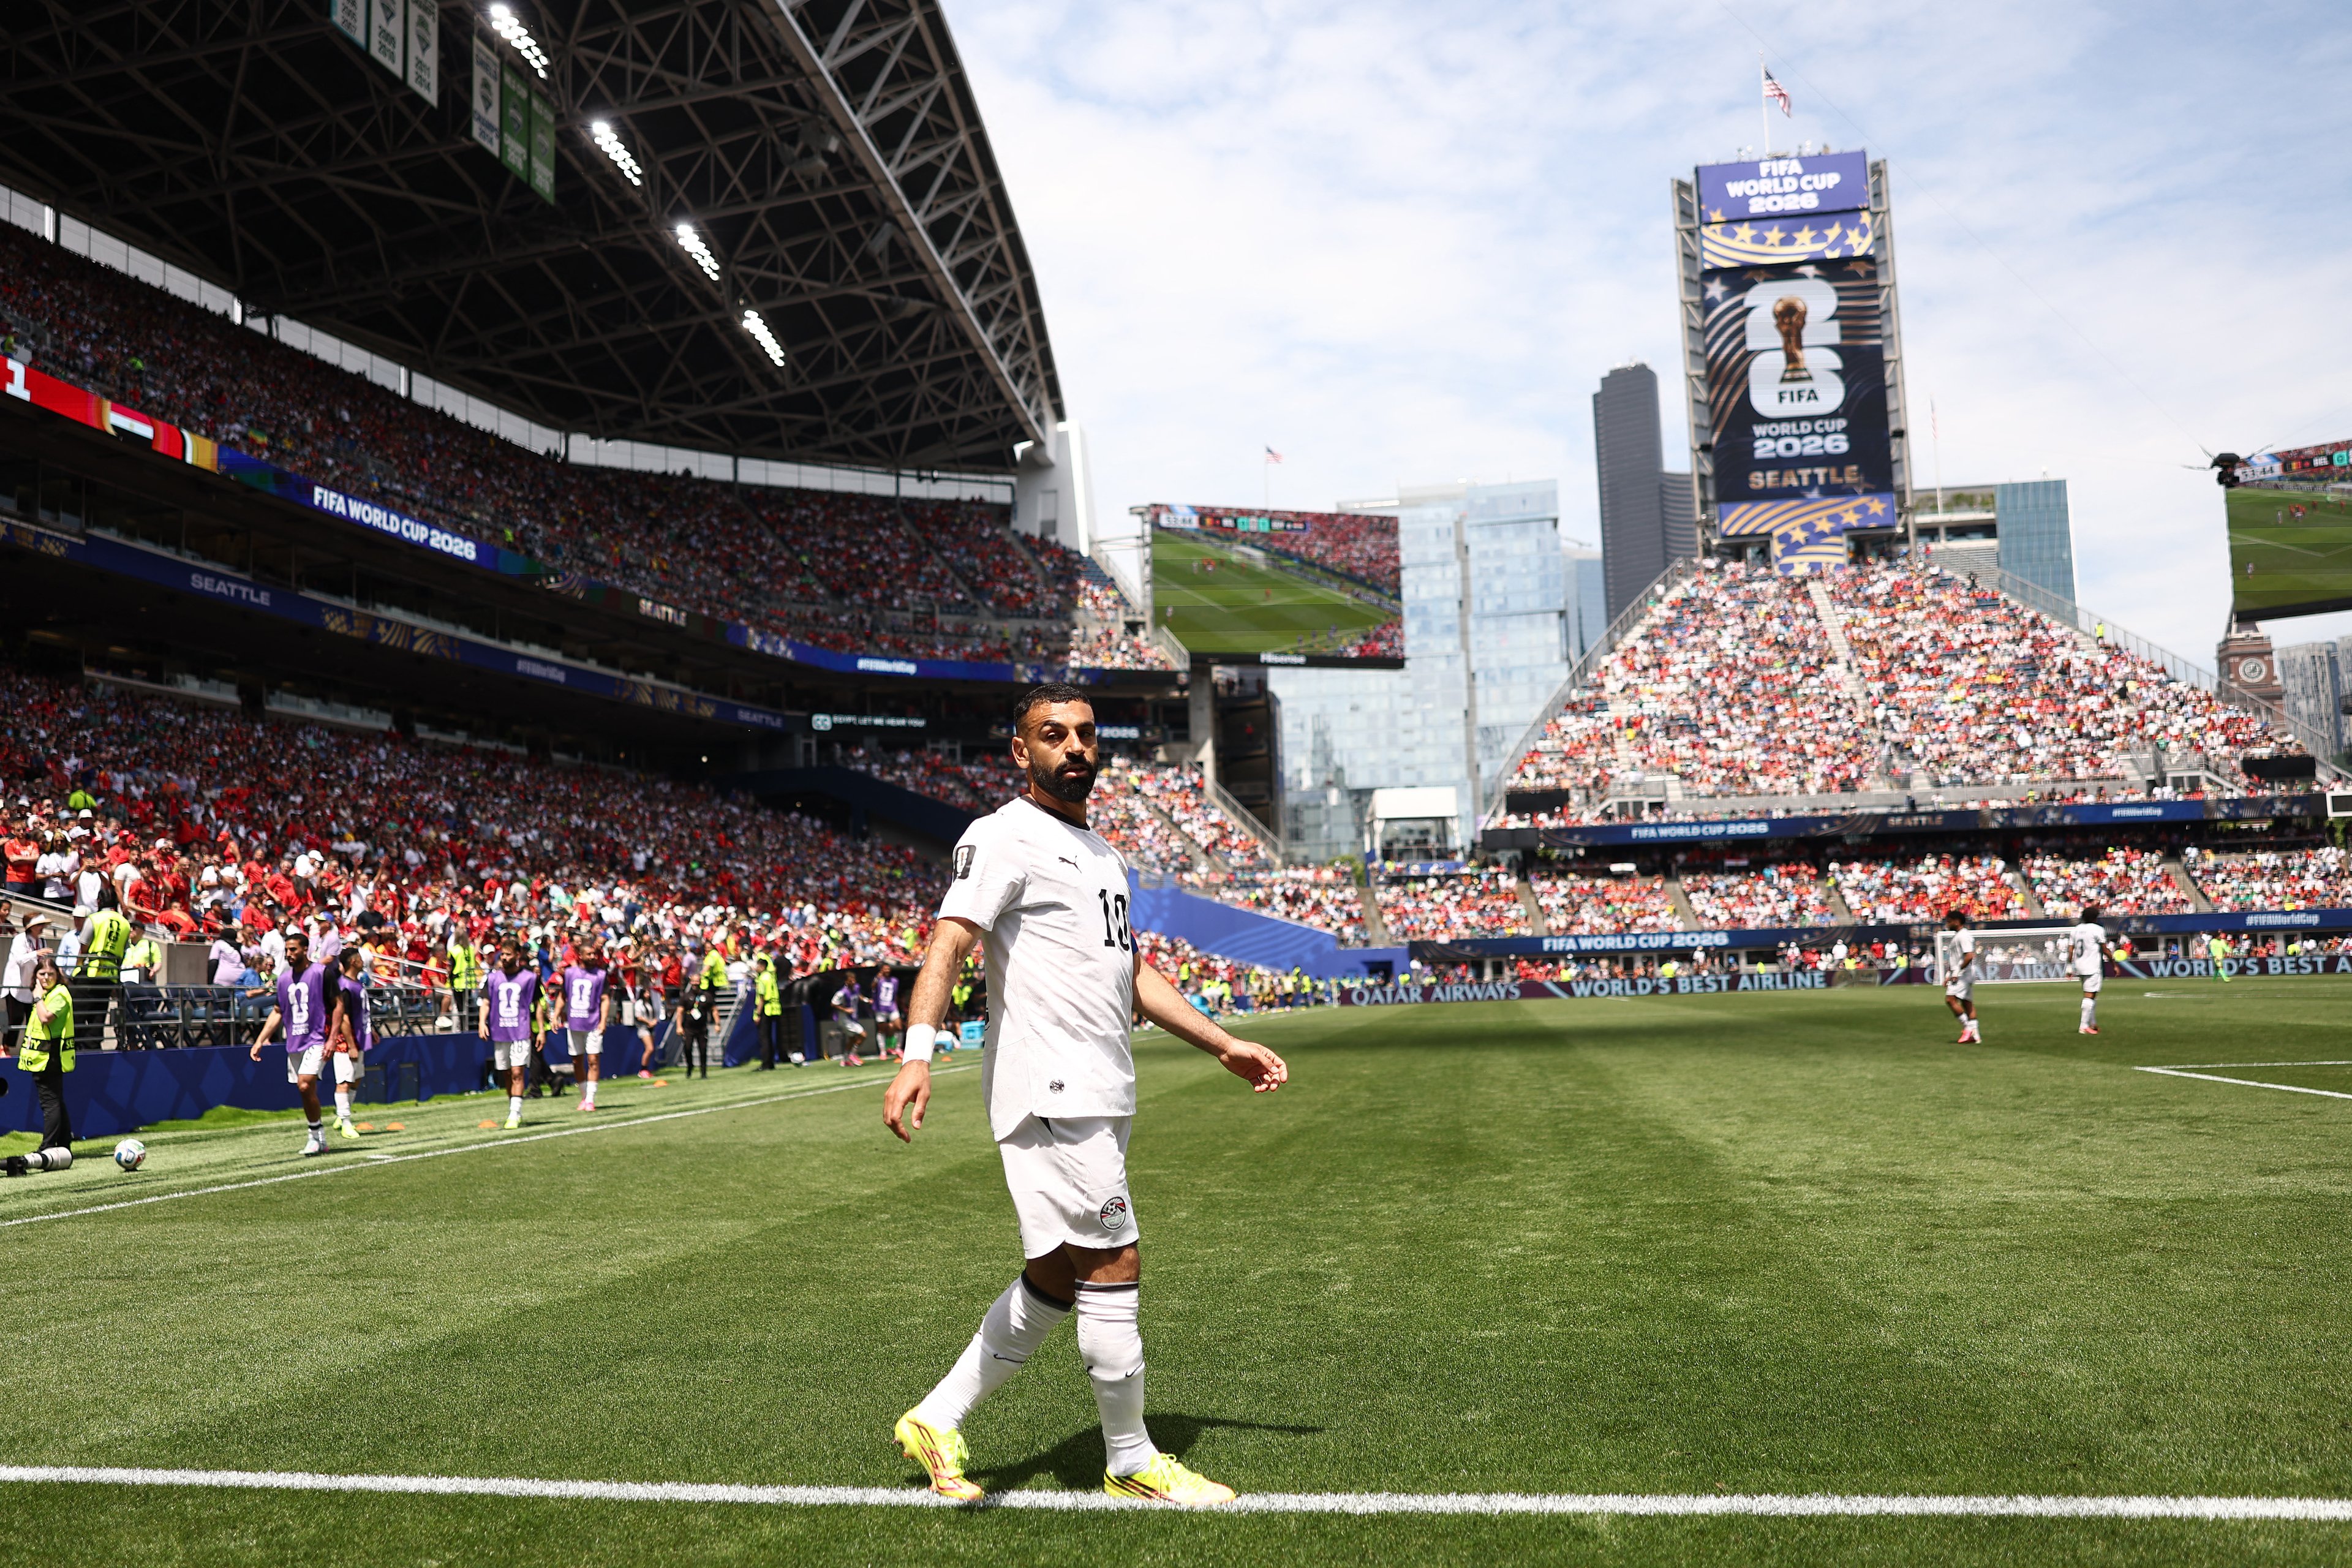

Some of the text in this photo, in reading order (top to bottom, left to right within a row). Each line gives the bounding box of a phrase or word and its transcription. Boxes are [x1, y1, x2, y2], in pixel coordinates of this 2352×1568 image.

[1759, 158, 1804, 177] FIFA
[1725, 172, 1841, 198] WORLD CUP
[1748, 192, 1820, 214] 2026
[1778, 389, 1819, 404] FIFA
[1752, 418, 1848, 438] WORLD CUP
[1753, 432, 1850, 460] 2026
[1749, 464, 1860, 491] SEATTLE
[314, 485, 478, 561] FIFA WORLD CUP 2026
[190, 573, 271, 607] SEATTLE
[737, 709, 783, 728] SEATTLE
[1631, 822, 1770, 840] FIFA WORLD CUP 2026
[1887, 815, 1944, 827] SEATTLE
[1098, 889, 1130, 952] 10
[2245, 912, 2320, 926] #FIFAWorldCup
[1542, 931, 1730, 952] FIFA WORLD CUP 2026
[2266, 956, 2327, 975] BEST
[1351, 982, 1522, 1006] QATAR AIRWAYS
[1570, 970, 1827, 998] WORLD'S BEST AIRLINE
